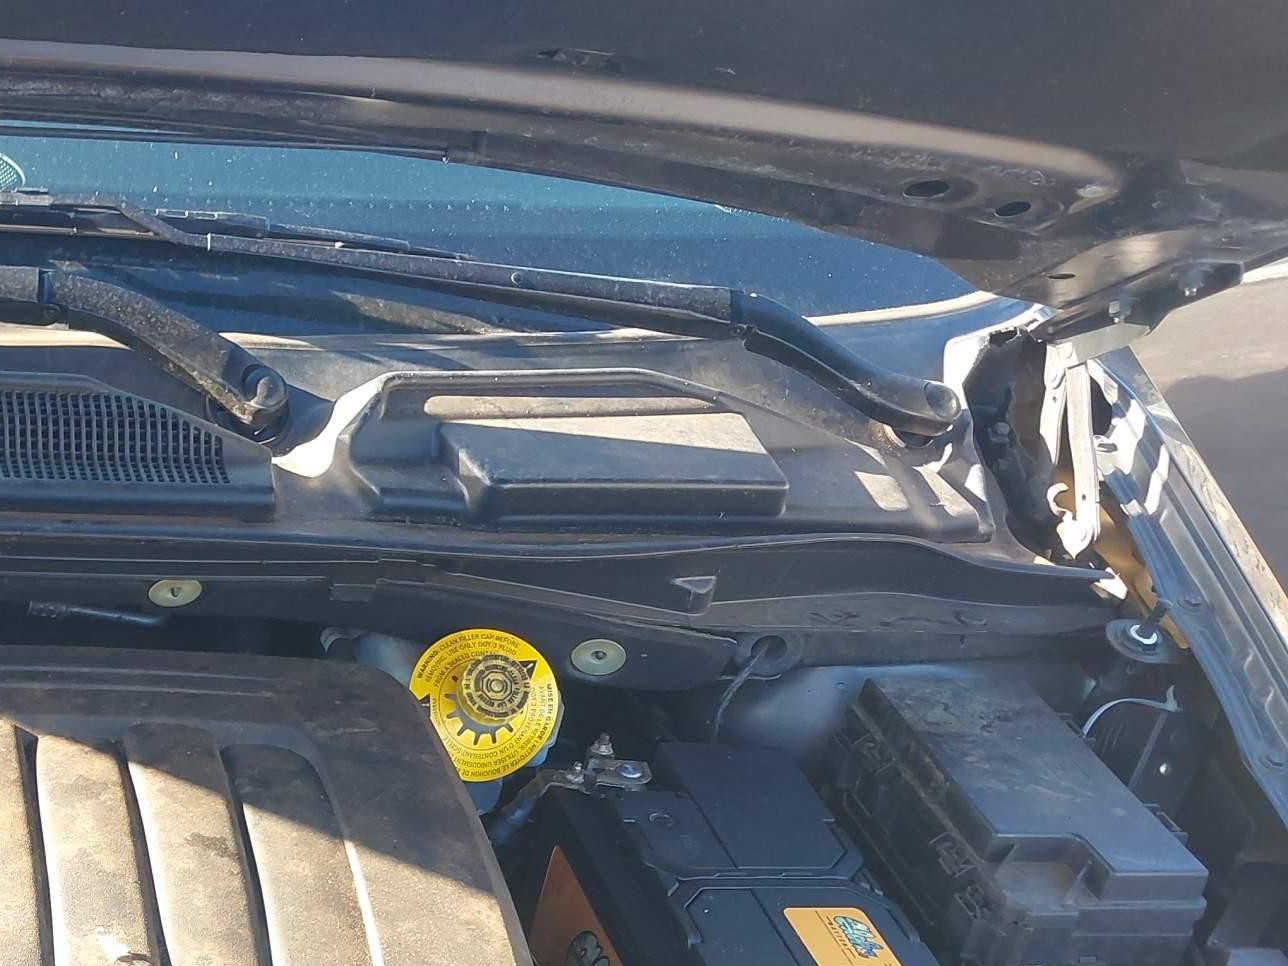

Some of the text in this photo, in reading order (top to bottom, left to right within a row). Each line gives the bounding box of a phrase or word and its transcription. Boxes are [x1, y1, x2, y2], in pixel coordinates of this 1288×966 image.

[459, 641, 475, 652] ONLY
[416, 649, 439, 679] WARNING:
[434, 670, 445, 687] FROM
[548, 705, 553, 714] EN
[538, 716, 551, 740] GARDE
